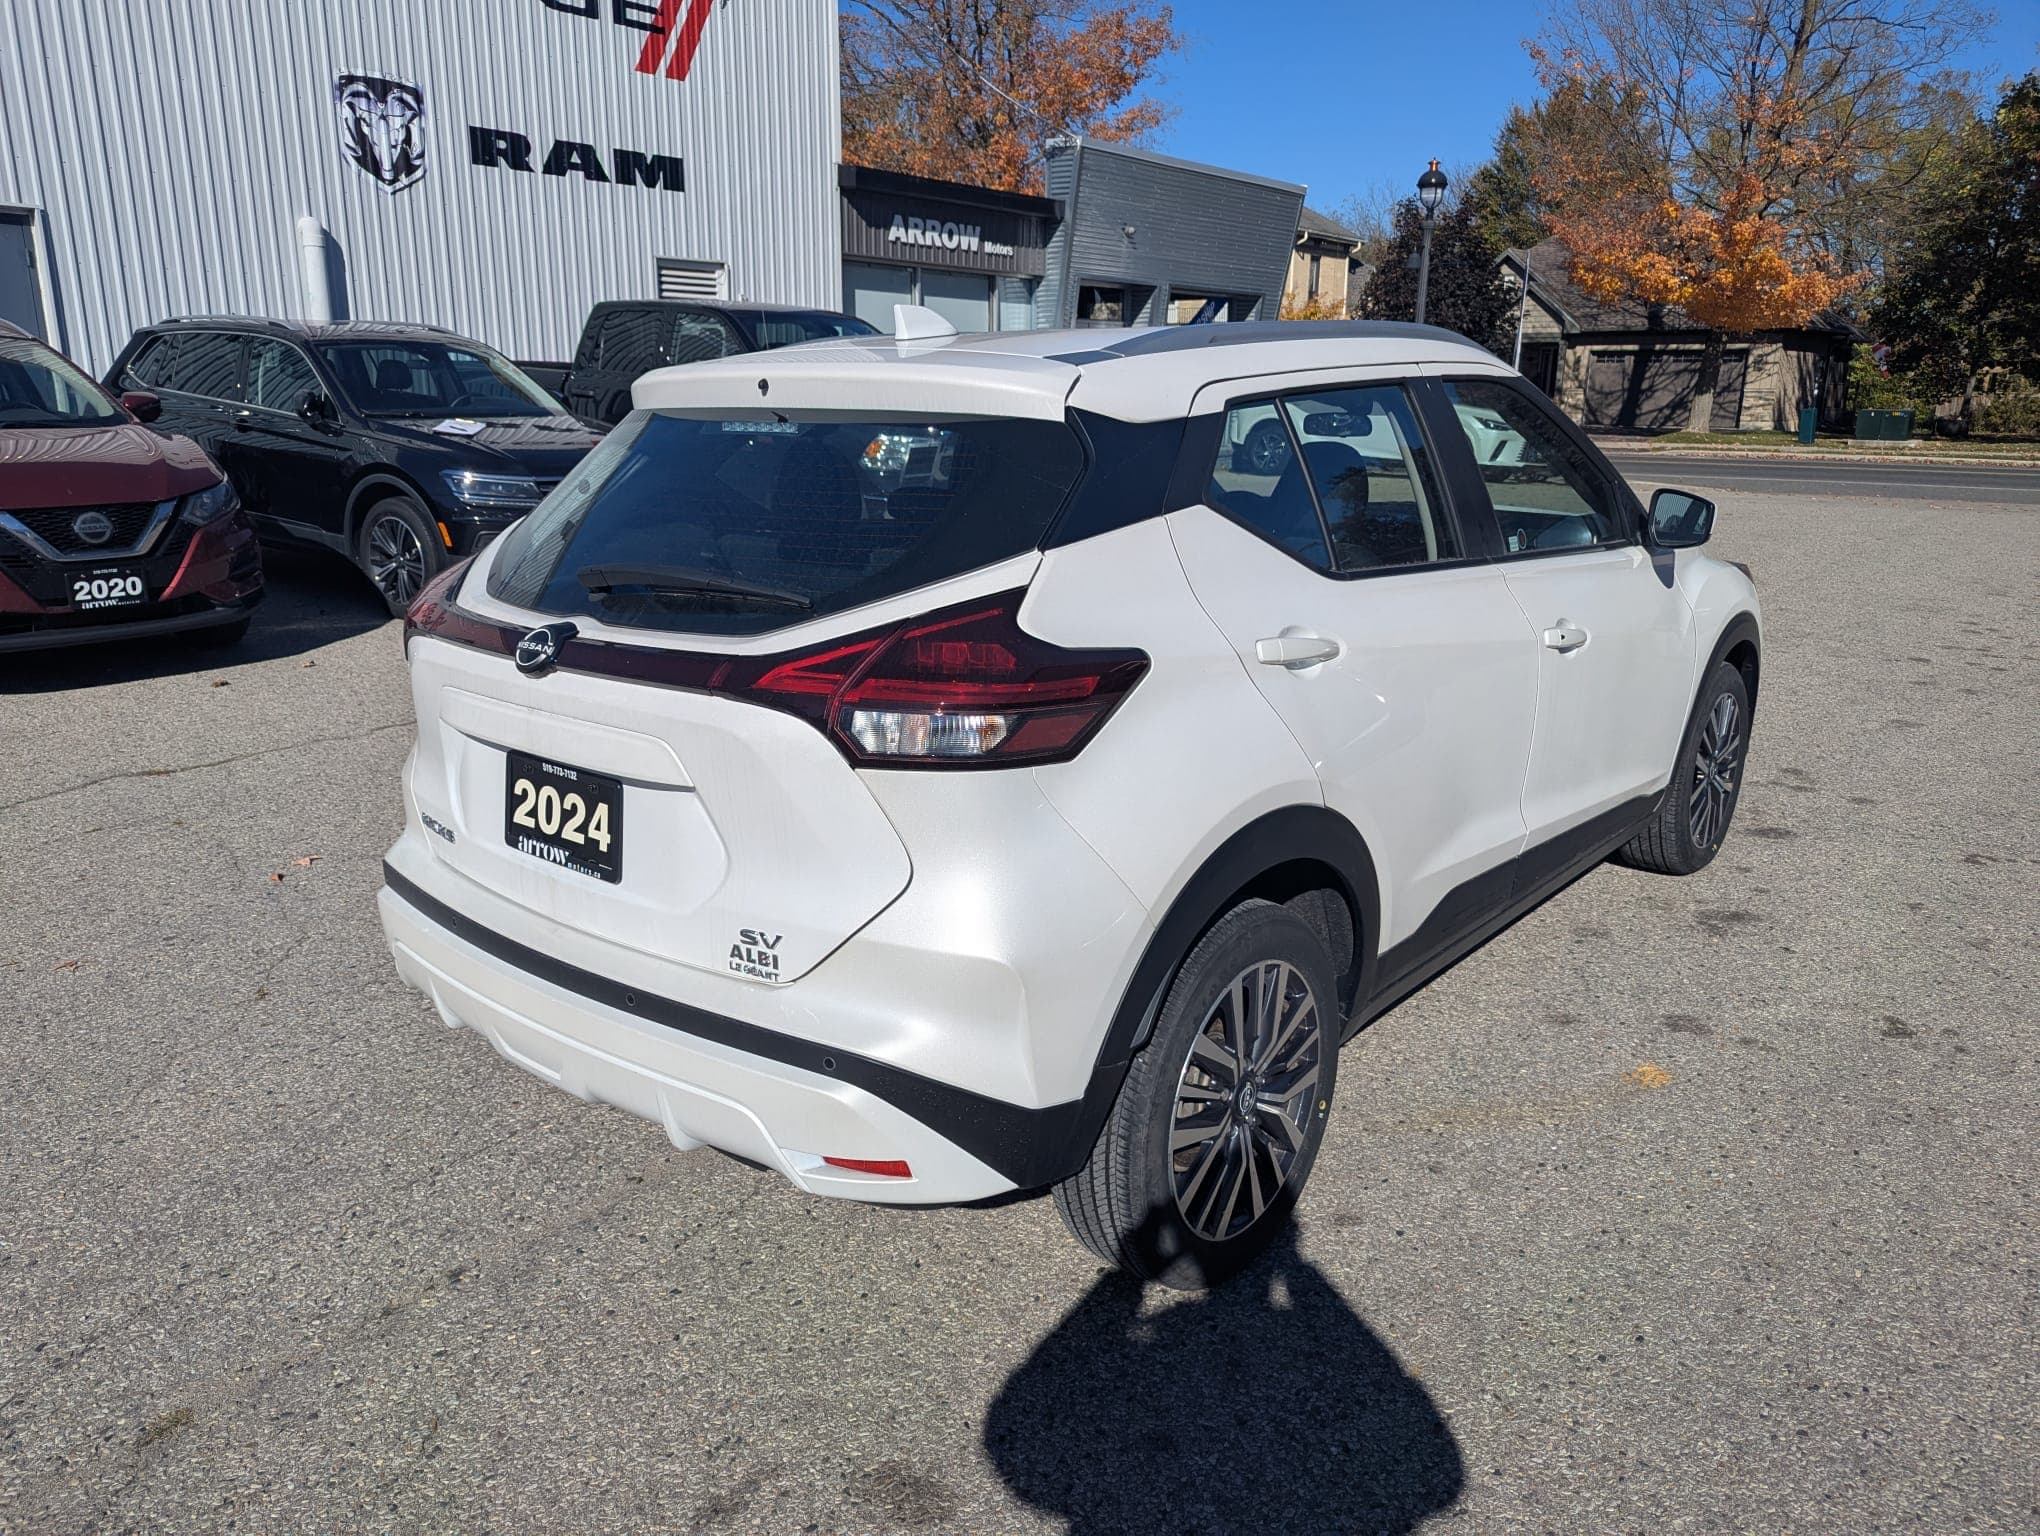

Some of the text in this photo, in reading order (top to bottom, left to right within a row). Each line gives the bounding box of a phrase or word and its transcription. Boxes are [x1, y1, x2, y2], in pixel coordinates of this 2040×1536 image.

[468, 125, 685, 192] RAM
[888, 214, 1014, 256] ARROW Motors
[73, 577, 142, 601] 2020
[81, 599, 119, 610] arrow
[517, 641, 555, 656] NISSAN
[513, 778, 611, 853] 2024
[518, 835, 569, 866] arrow
[739, 928, 783, 950] SV
[729, 944, 779, 970] ALBI
